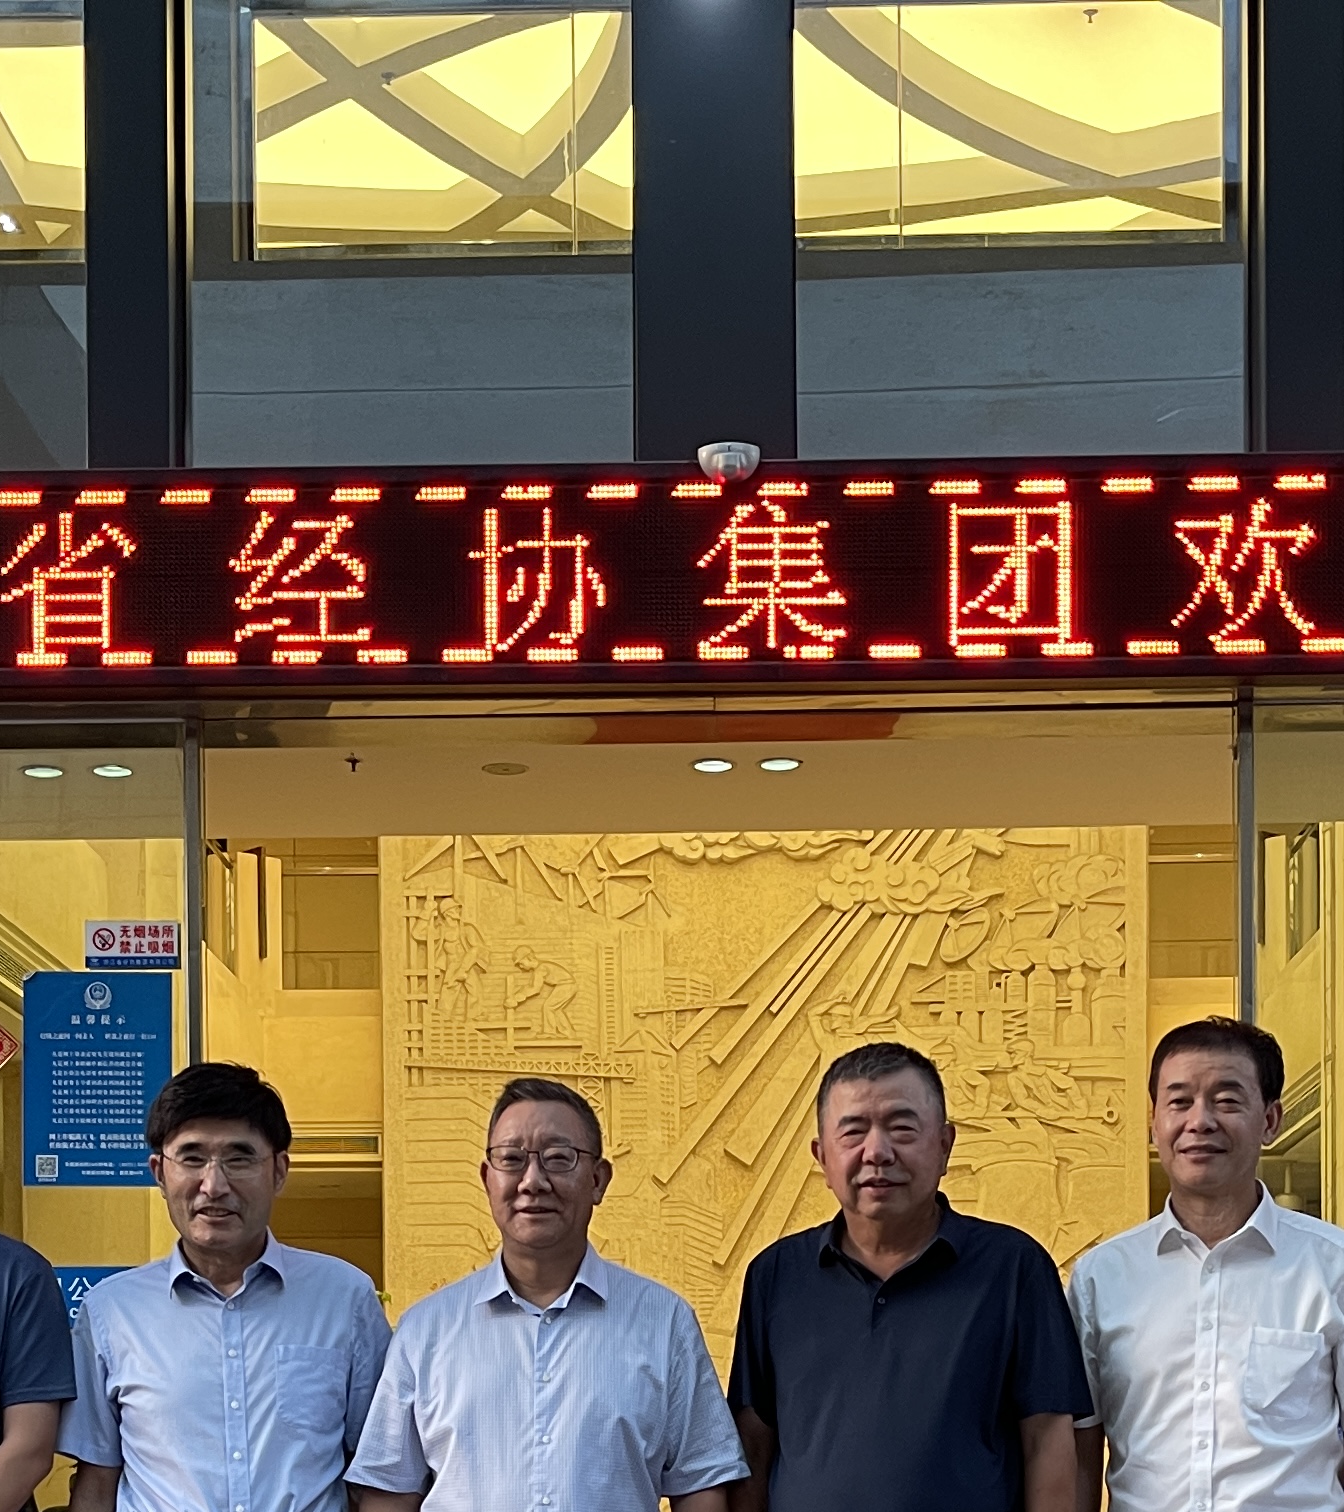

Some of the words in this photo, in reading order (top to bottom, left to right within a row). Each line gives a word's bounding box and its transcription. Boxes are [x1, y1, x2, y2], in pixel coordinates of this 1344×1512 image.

[119, 925, 175, 938] 无烟场所
[119, 940, 175, 954] 禁止吸烟
